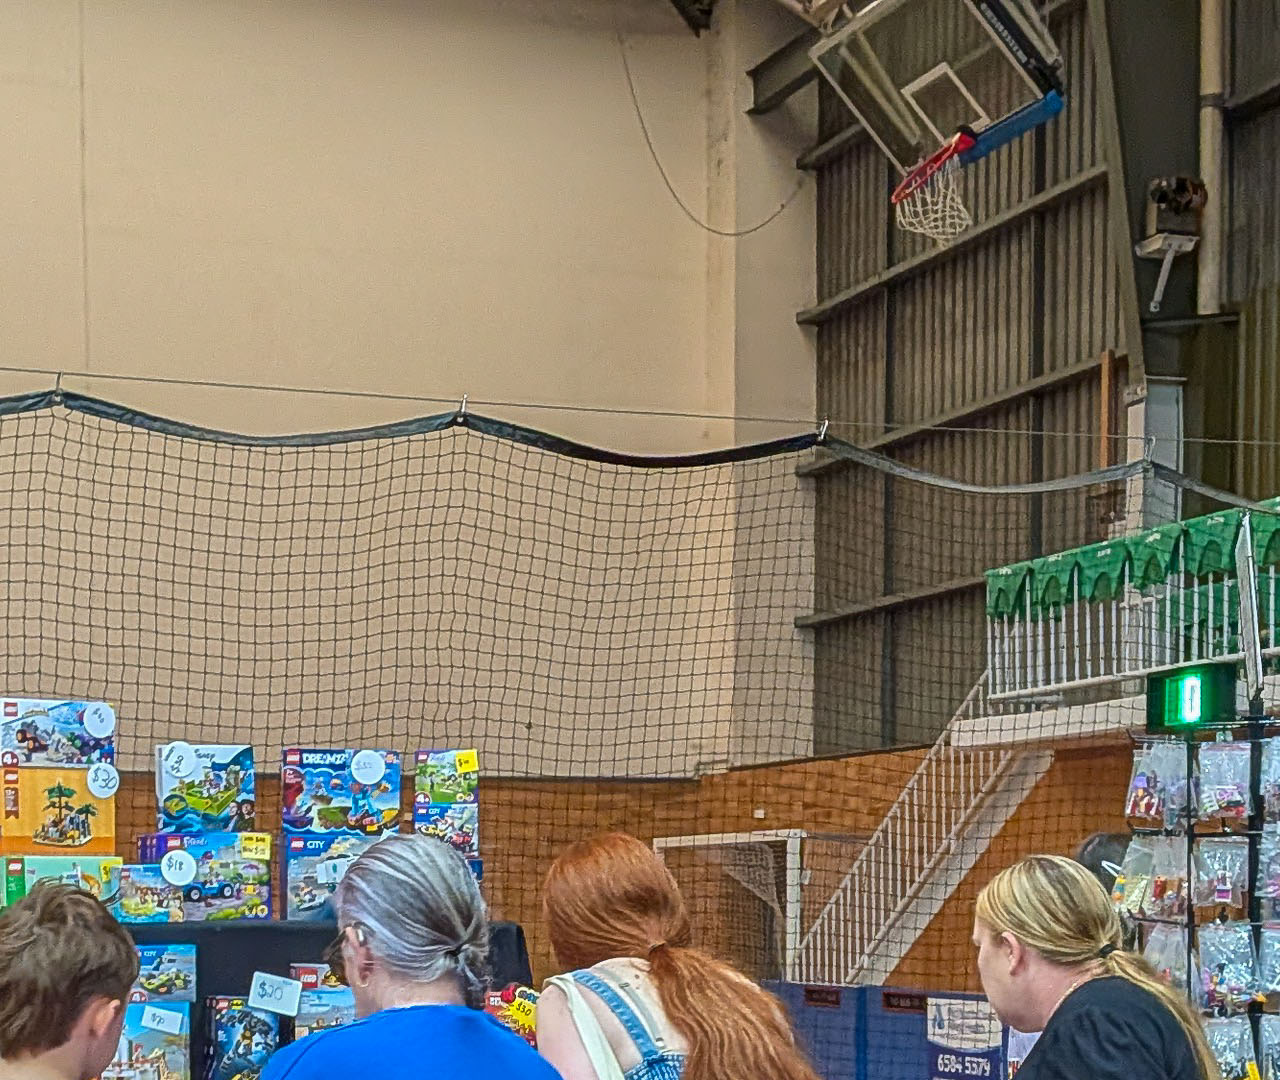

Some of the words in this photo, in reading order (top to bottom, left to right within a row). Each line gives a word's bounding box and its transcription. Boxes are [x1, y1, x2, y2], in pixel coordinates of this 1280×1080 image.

[92, 766, 119, 790] $30
[306, 840, 325, 850] CITY
[166, 855, 184, 872] $18
[300, 974, 317, 983] LEGO
[257, 980, 284, 1001] $20
[515, 1001, 533, 1017] $30
